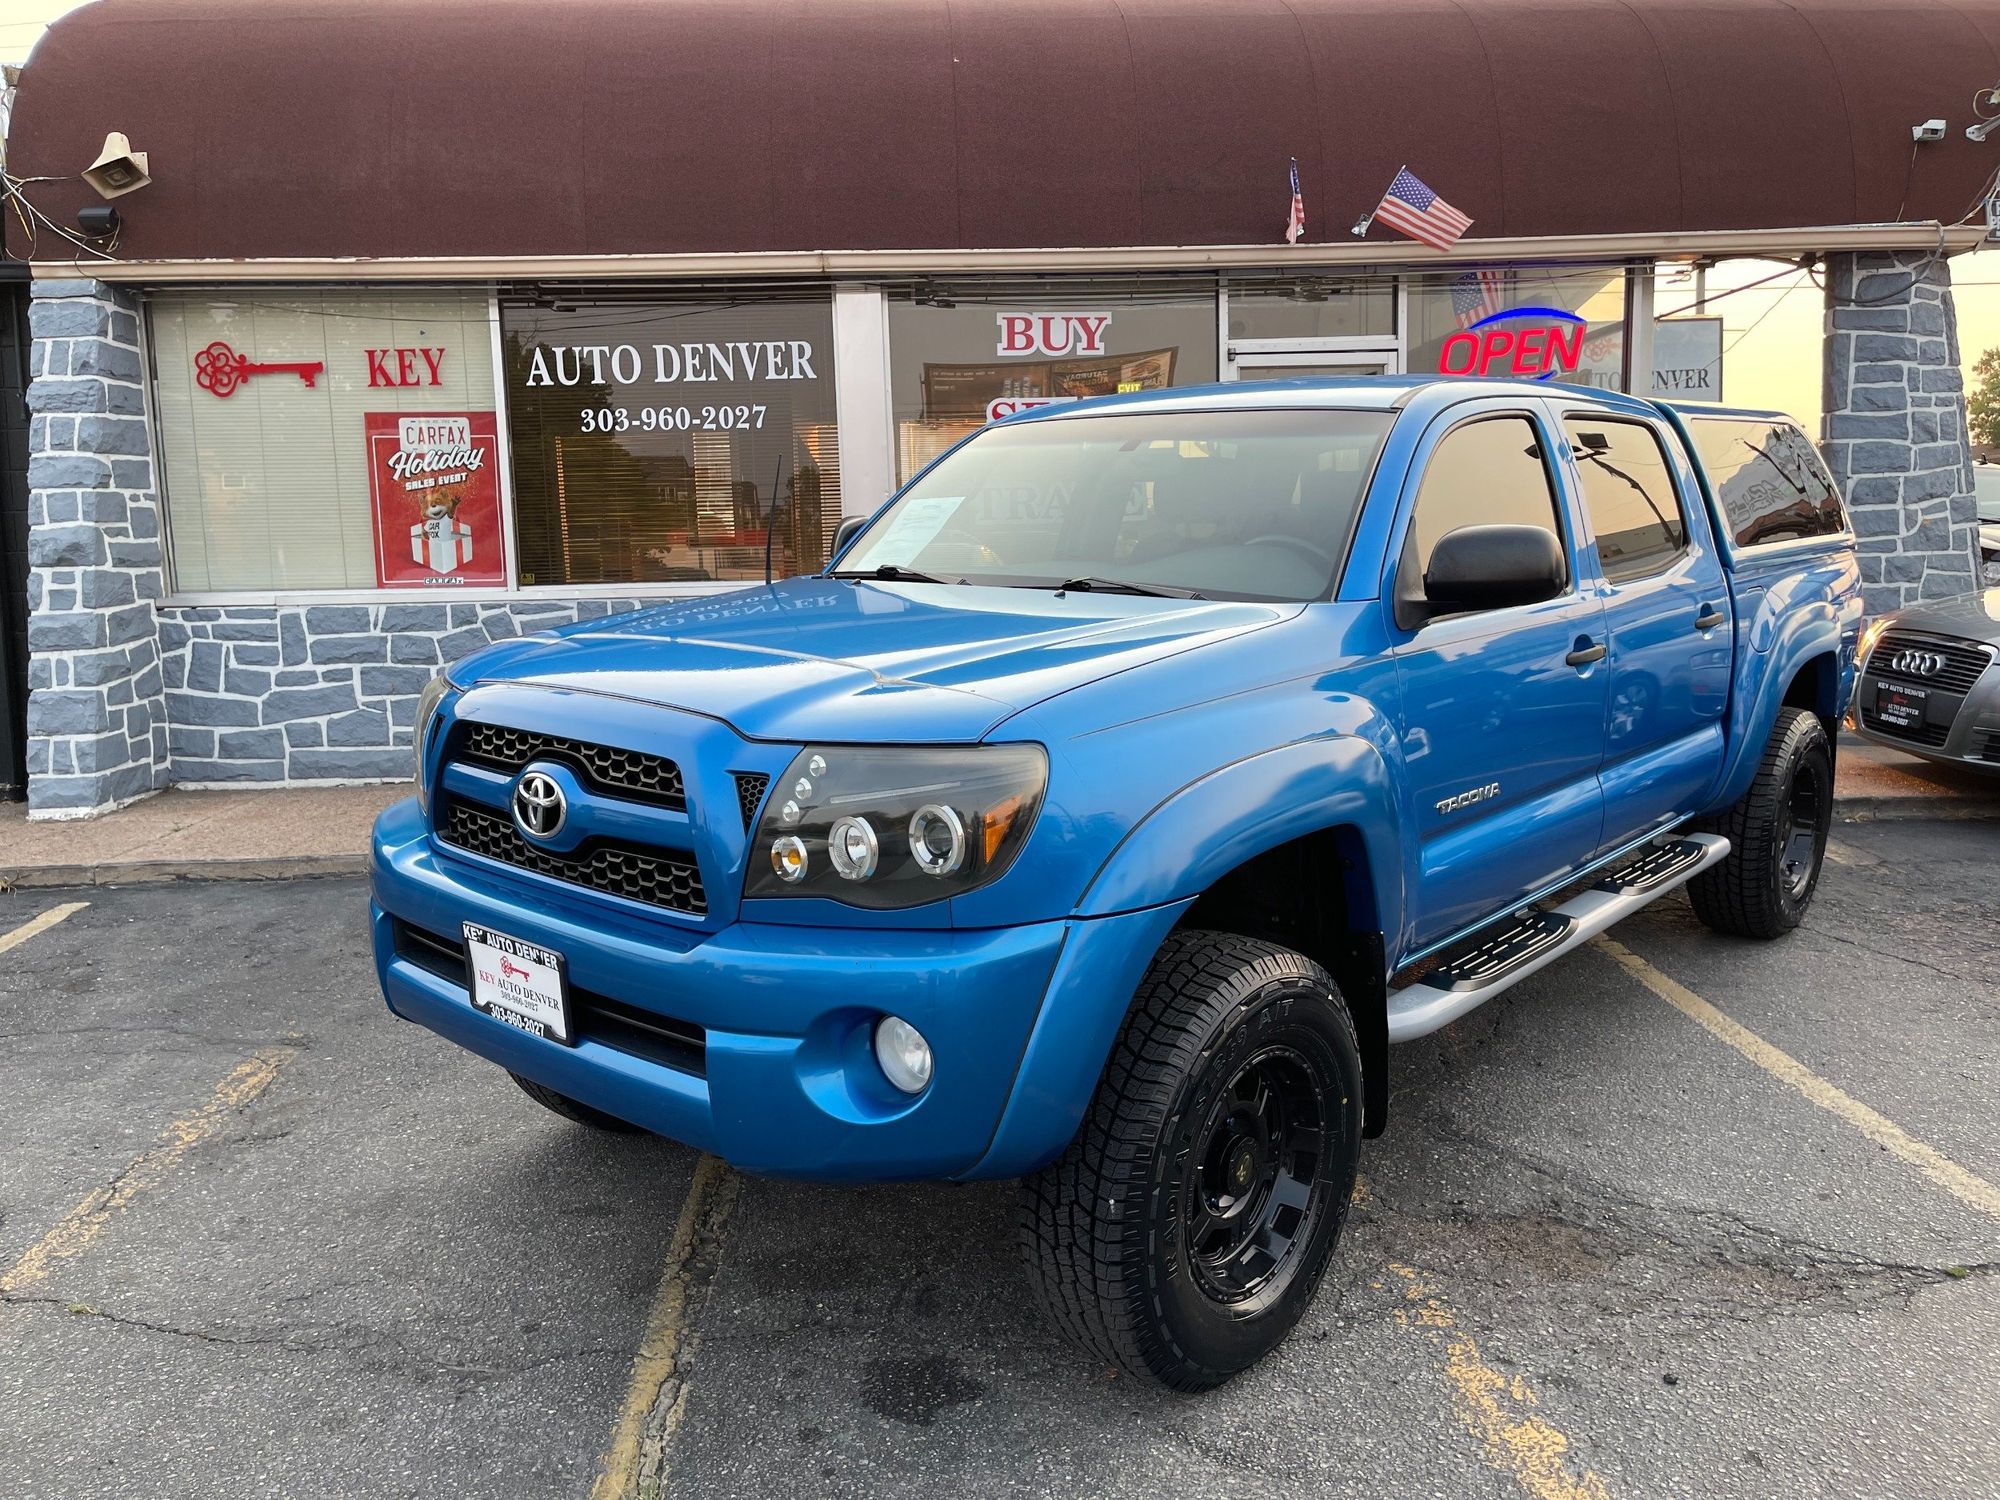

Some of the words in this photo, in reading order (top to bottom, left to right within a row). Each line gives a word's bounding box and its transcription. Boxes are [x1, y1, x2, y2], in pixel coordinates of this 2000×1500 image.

[1000, 314, 1109, 354] BUY
[1439, 323, 1587, 376] OPEN
[364, 347, 446, 388] KEY
[526, 344, 642, 387] AUTO
[652, 340, 817, 383] DENVER
[580, 404, 767, 433] 303-960-2027
[406, 426, 466, 445] CARFAX
[388, 445, 485, 481] Holiday
[405, 477, 436, 491] SALES
[438, 472, 468, 486] EVENT
[978, 483, 1148, 522] TRAE
[428, 522, 440, 530] CAR
[428, 531, 440, 539] FOX
[424, 577, 464, 585] CARFAX
[1890, 685, 1903, 693] AUTO
[1904, 688, 1925, 698] DENVER
[1887, 703, 1900, 711] AUTO
[1900, 706, 1919, 715] DENVER
[1436, 782, 1501, 815] TACOMA
[463, 924, 483, 942] KEY
[486, 932, 514, 953] AUTO
[515, 942, 559, 970] DENVER
[479, 969, 496, 985] KEY
[497, 979, 522, 995] AUTO
[523, 984, 560, 1011] DENVER
[501, 991, 538, 1012] 303-960-2027
[489, 1003, 545, 1037] 303-960-2027
[1259, 998, 1294, 1029] A/T
